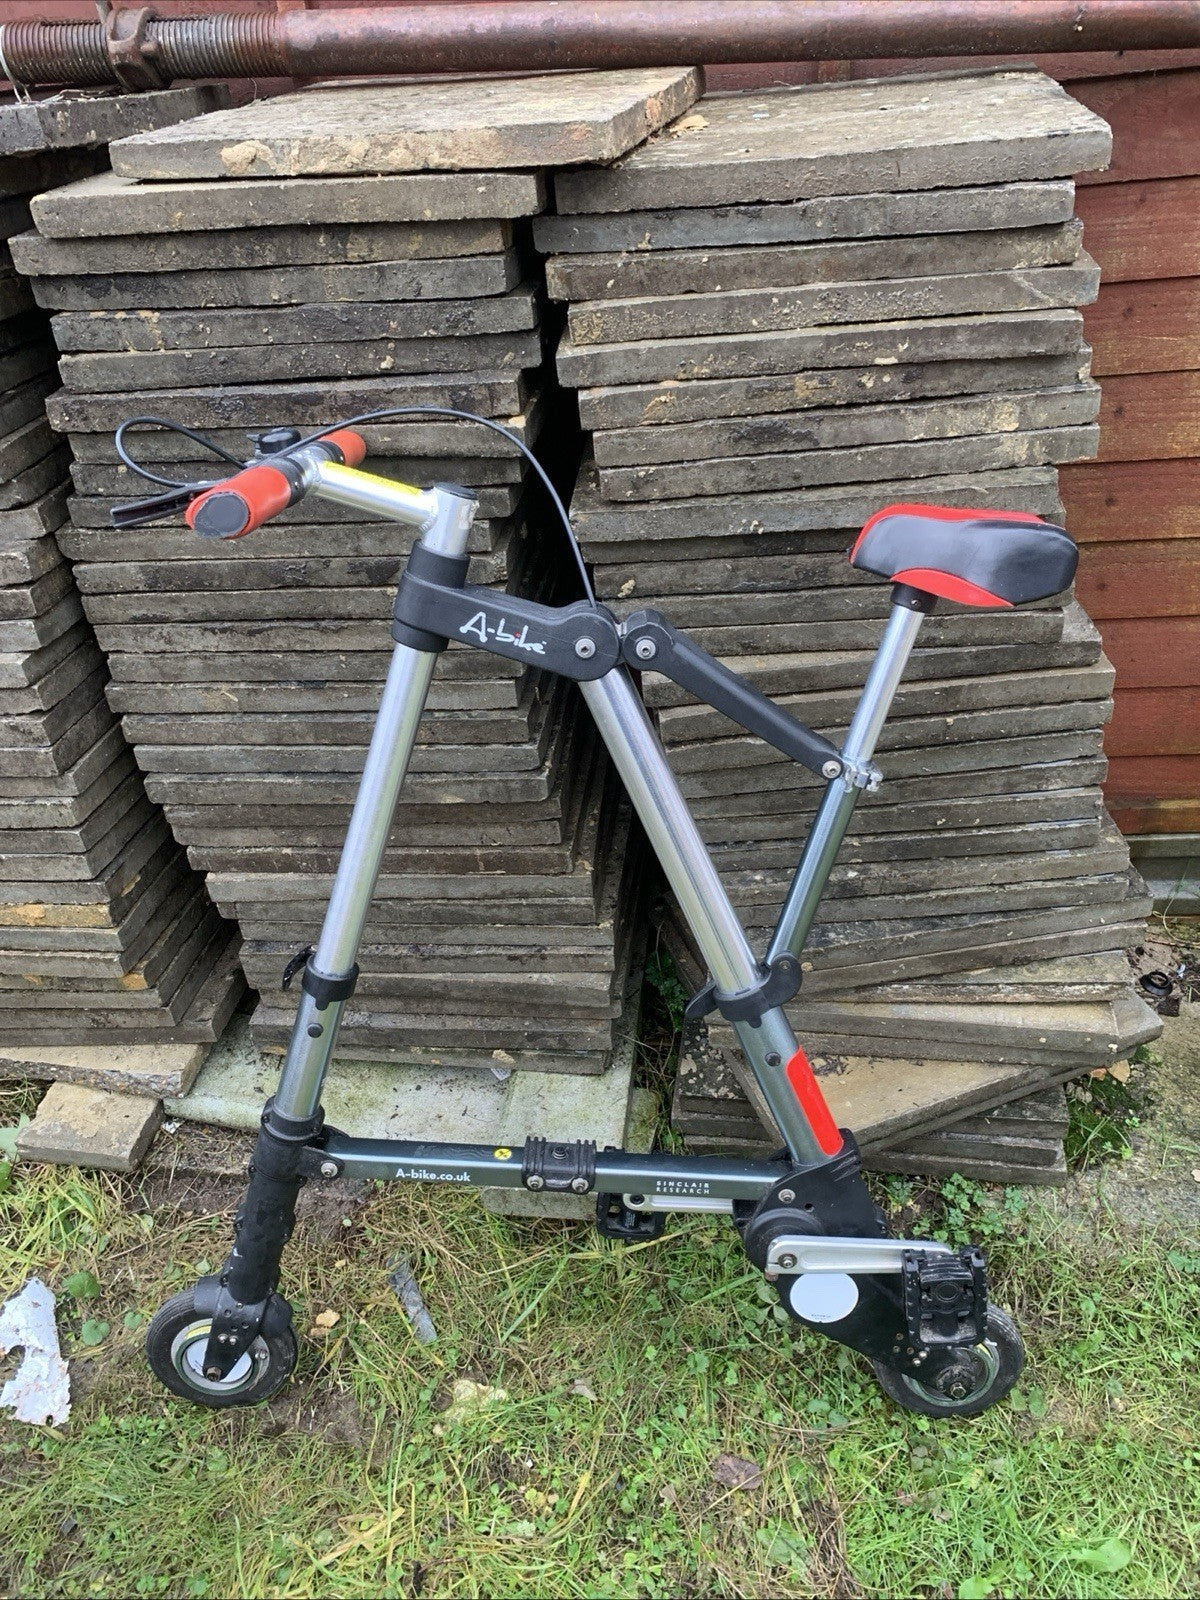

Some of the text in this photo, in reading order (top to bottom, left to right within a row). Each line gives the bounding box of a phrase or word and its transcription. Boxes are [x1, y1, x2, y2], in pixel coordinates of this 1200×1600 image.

[459, 611, 547, 654] A-bike
[395, 1168, 471, 1182] A-bike.co.uk
[656, 1180, 710, 1188] SINCLAIR
[656, 1187, 710, 1195] RESEARCH
